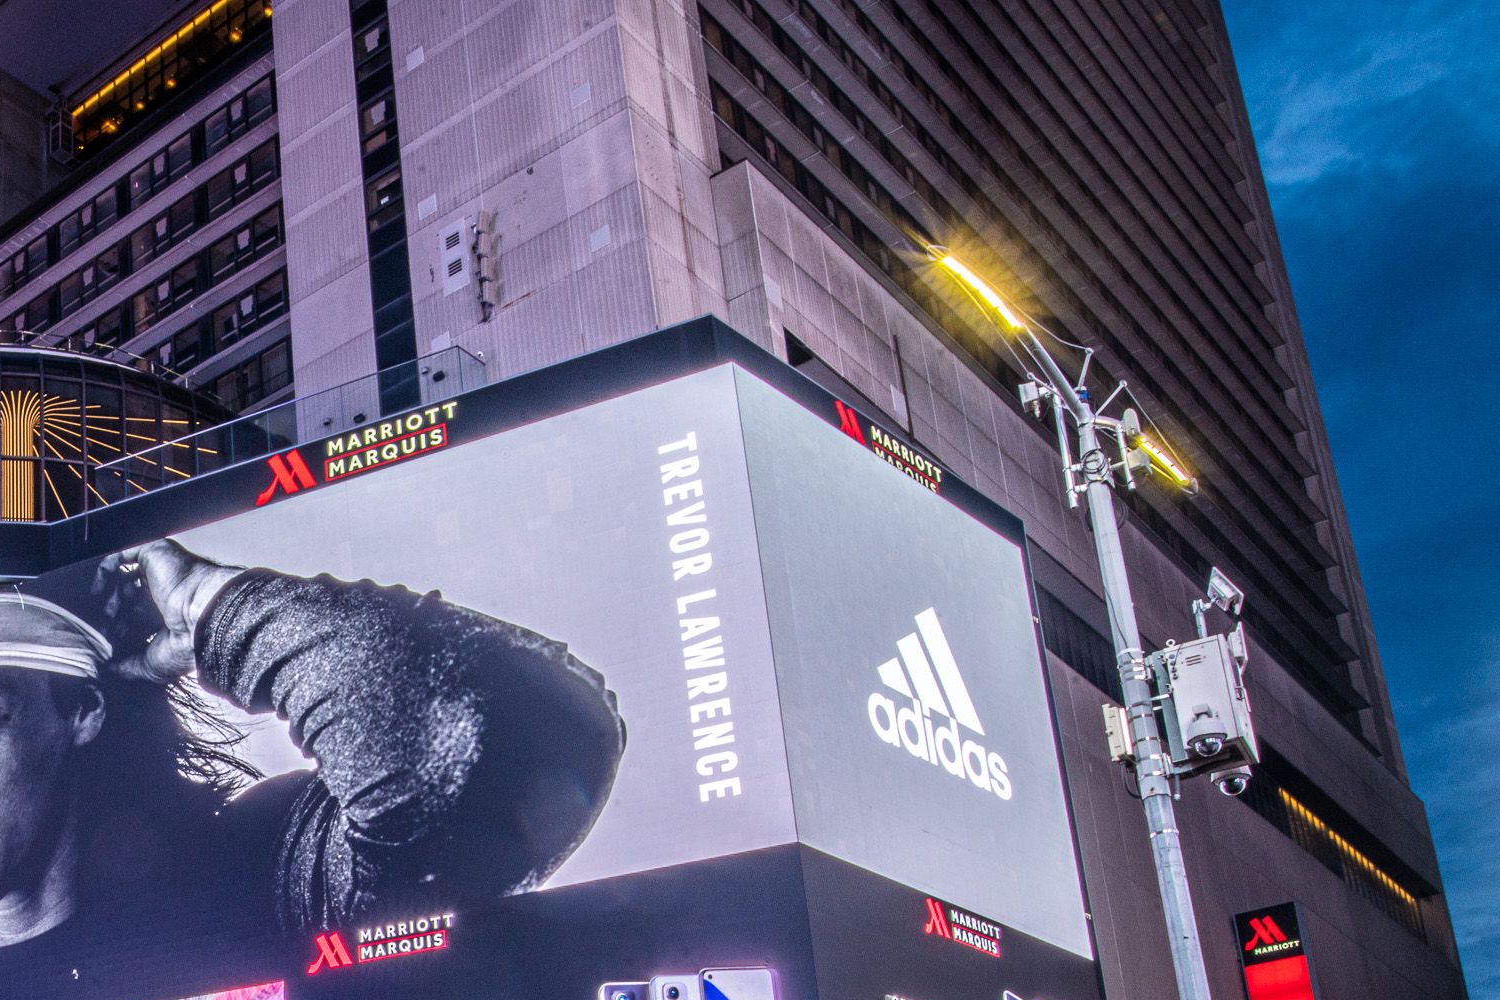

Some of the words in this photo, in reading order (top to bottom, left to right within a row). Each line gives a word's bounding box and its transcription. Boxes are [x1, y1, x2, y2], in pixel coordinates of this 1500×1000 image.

[326, 400, 457, 456] MARRIOTT
[326, 426, 443, 478] MARQUIS
[871, 425, 942, 483] MARRIOTT
[657, 430, 714, 582] TREVOR
[675, 588, 742, 804] LAWRENCE
[867, 692, 1013, 801] adidas
[359, 914, 454, 943] MARRIOTT
[359, 932, 445, 960] MARQUIS
[951, 909, 1000, 940] MARRIOTT
[953, 926, 998, 954] MARQUIS
[1255, 940, 1300, 955] MARRIOTT
